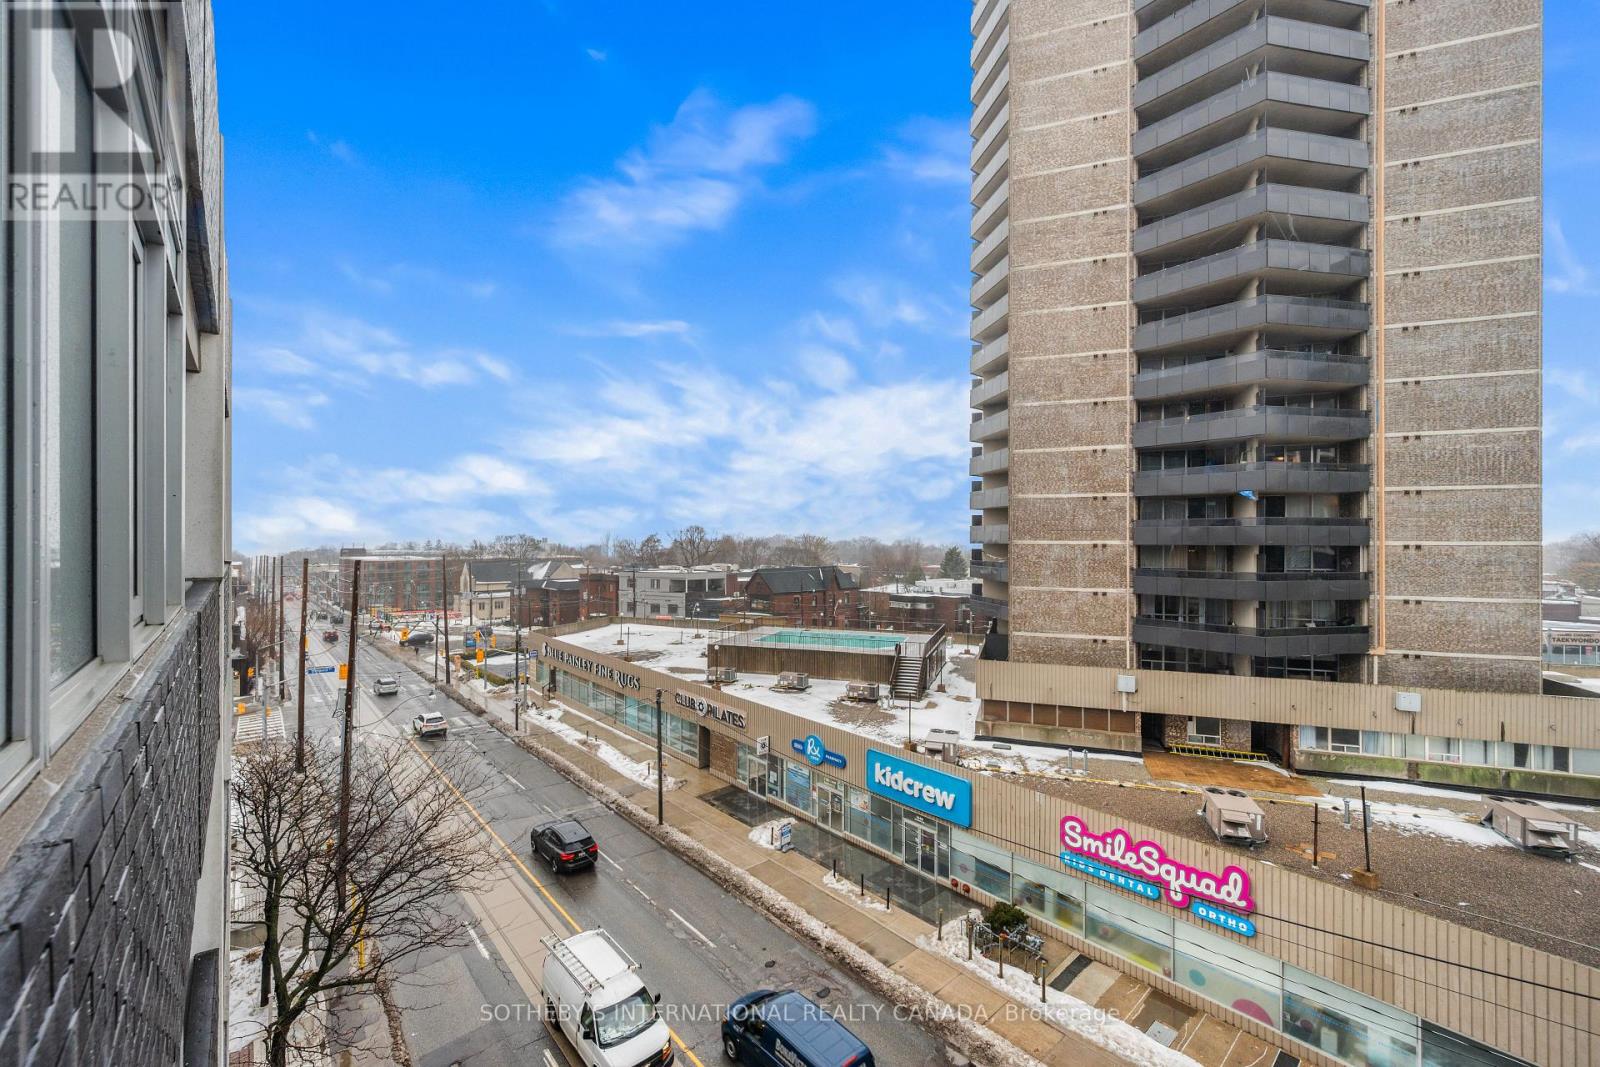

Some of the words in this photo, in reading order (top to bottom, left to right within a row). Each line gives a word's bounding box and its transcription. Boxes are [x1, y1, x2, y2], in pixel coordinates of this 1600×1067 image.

[547, 646, 564, 662] BLUE
[564, 652, 593, 672] PAISLEY
[594, 663, 614, 680] FINE
[614, 670, 641, 691] RUGS
[674, 692, 697, 711] CLUB
[706, 703, 746, 729] PILATES
[874, 762, 956, 811] kidcrew
[1064, 820, 1248, 907] SmileSquad
[1064, 855, 1095, 873] KIDS
[1099, 868, 1154, 897] DENTAL
[1198, 906, 1248, 932] ORTHO
